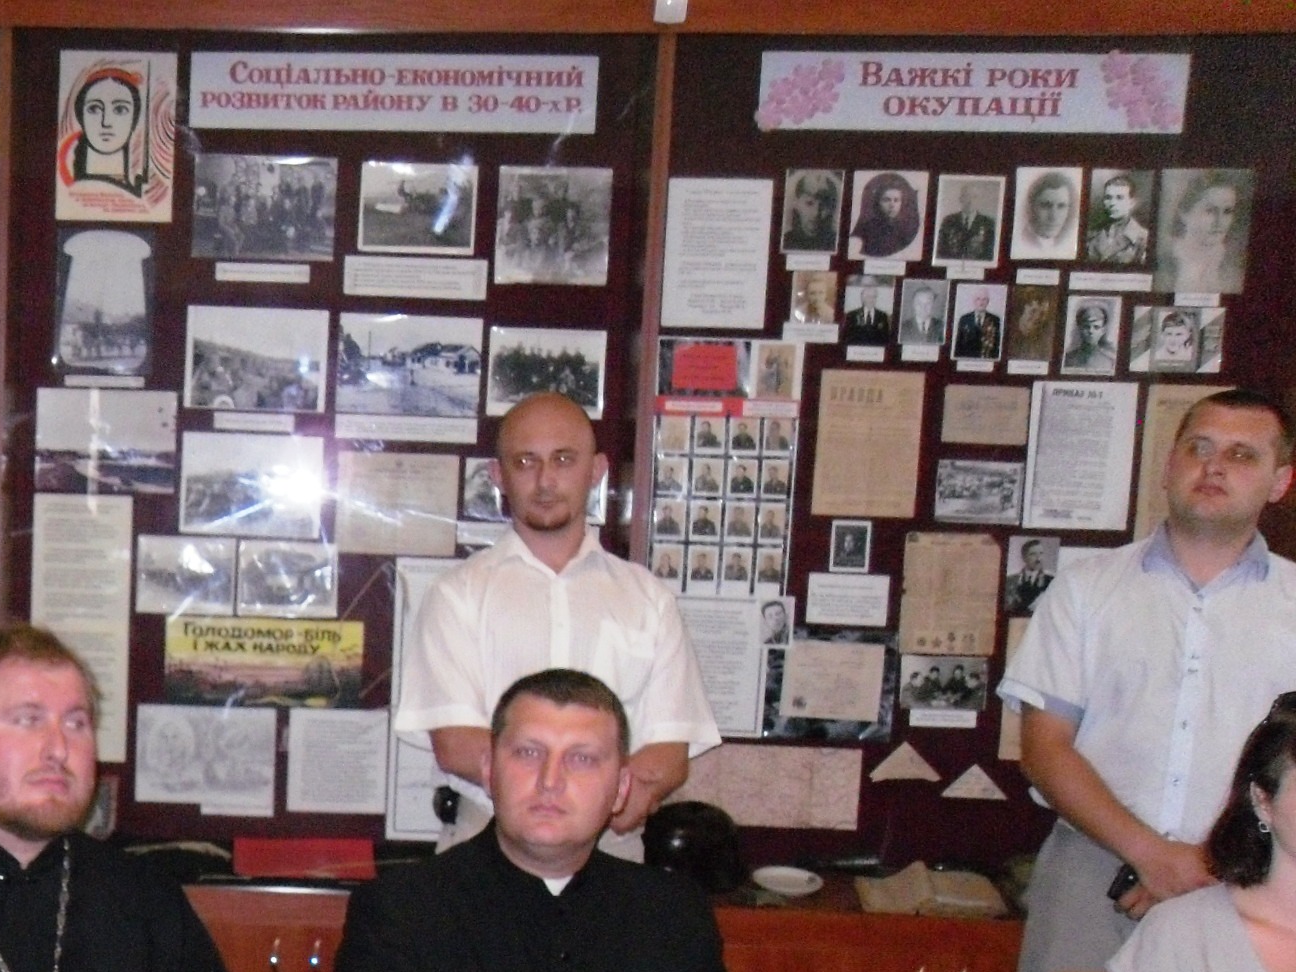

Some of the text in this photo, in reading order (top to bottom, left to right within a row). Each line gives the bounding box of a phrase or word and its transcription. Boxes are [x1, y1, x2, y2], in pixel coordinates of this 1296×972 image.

[859, 61, 1080, 89] ВАЖКІ РОКИ
[200, 91, 327, 112] РОЗВИТОК
[332, 89, 432, 113] РАЙОНУ
[440, 95, 459, 112] В
[882, 92, 1063, 123] ОКУПАЦІЇ
[204, 640, 247, 652] ЖАХ
[252, 642, 321, 655] НАРОДУ
